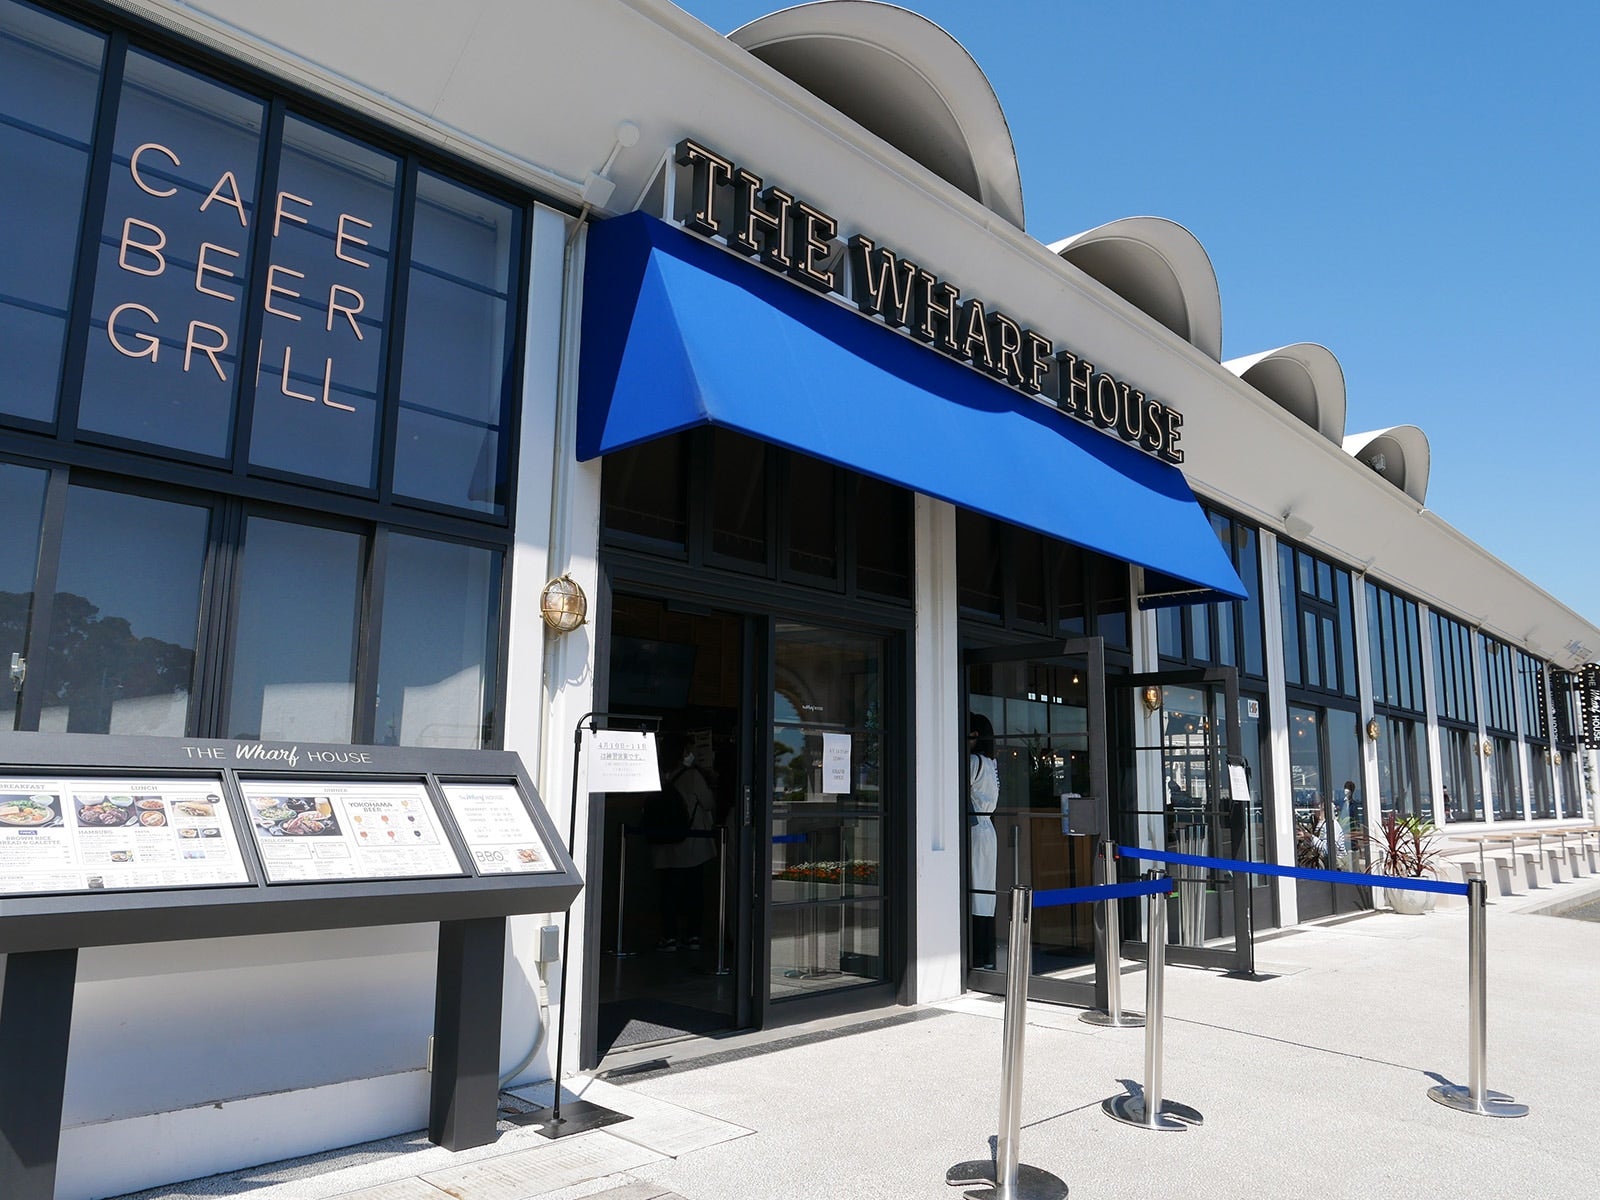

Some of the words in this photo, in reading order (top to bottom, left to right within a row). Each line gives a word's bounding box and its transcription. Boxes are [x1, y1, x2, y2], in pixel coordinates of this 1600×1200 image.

[130, 143, 373, 267] CAFE
[118, 217, 365, 341] BEER
[675, 137, 837, 294] THE
[847, 233, 1053, 396] WHARF
[1056, 349, 1185, 465] HOUSE
[107, 302, 356, 412] GRILL
[181, 746, 227, 760] THE
[235, 743, 299, 768] Wharf
[307, 751, 373, 764] HOUSE
[1591, 715, 1600, 742] HOUSE
[475, 850, 504, 862] BBQ
